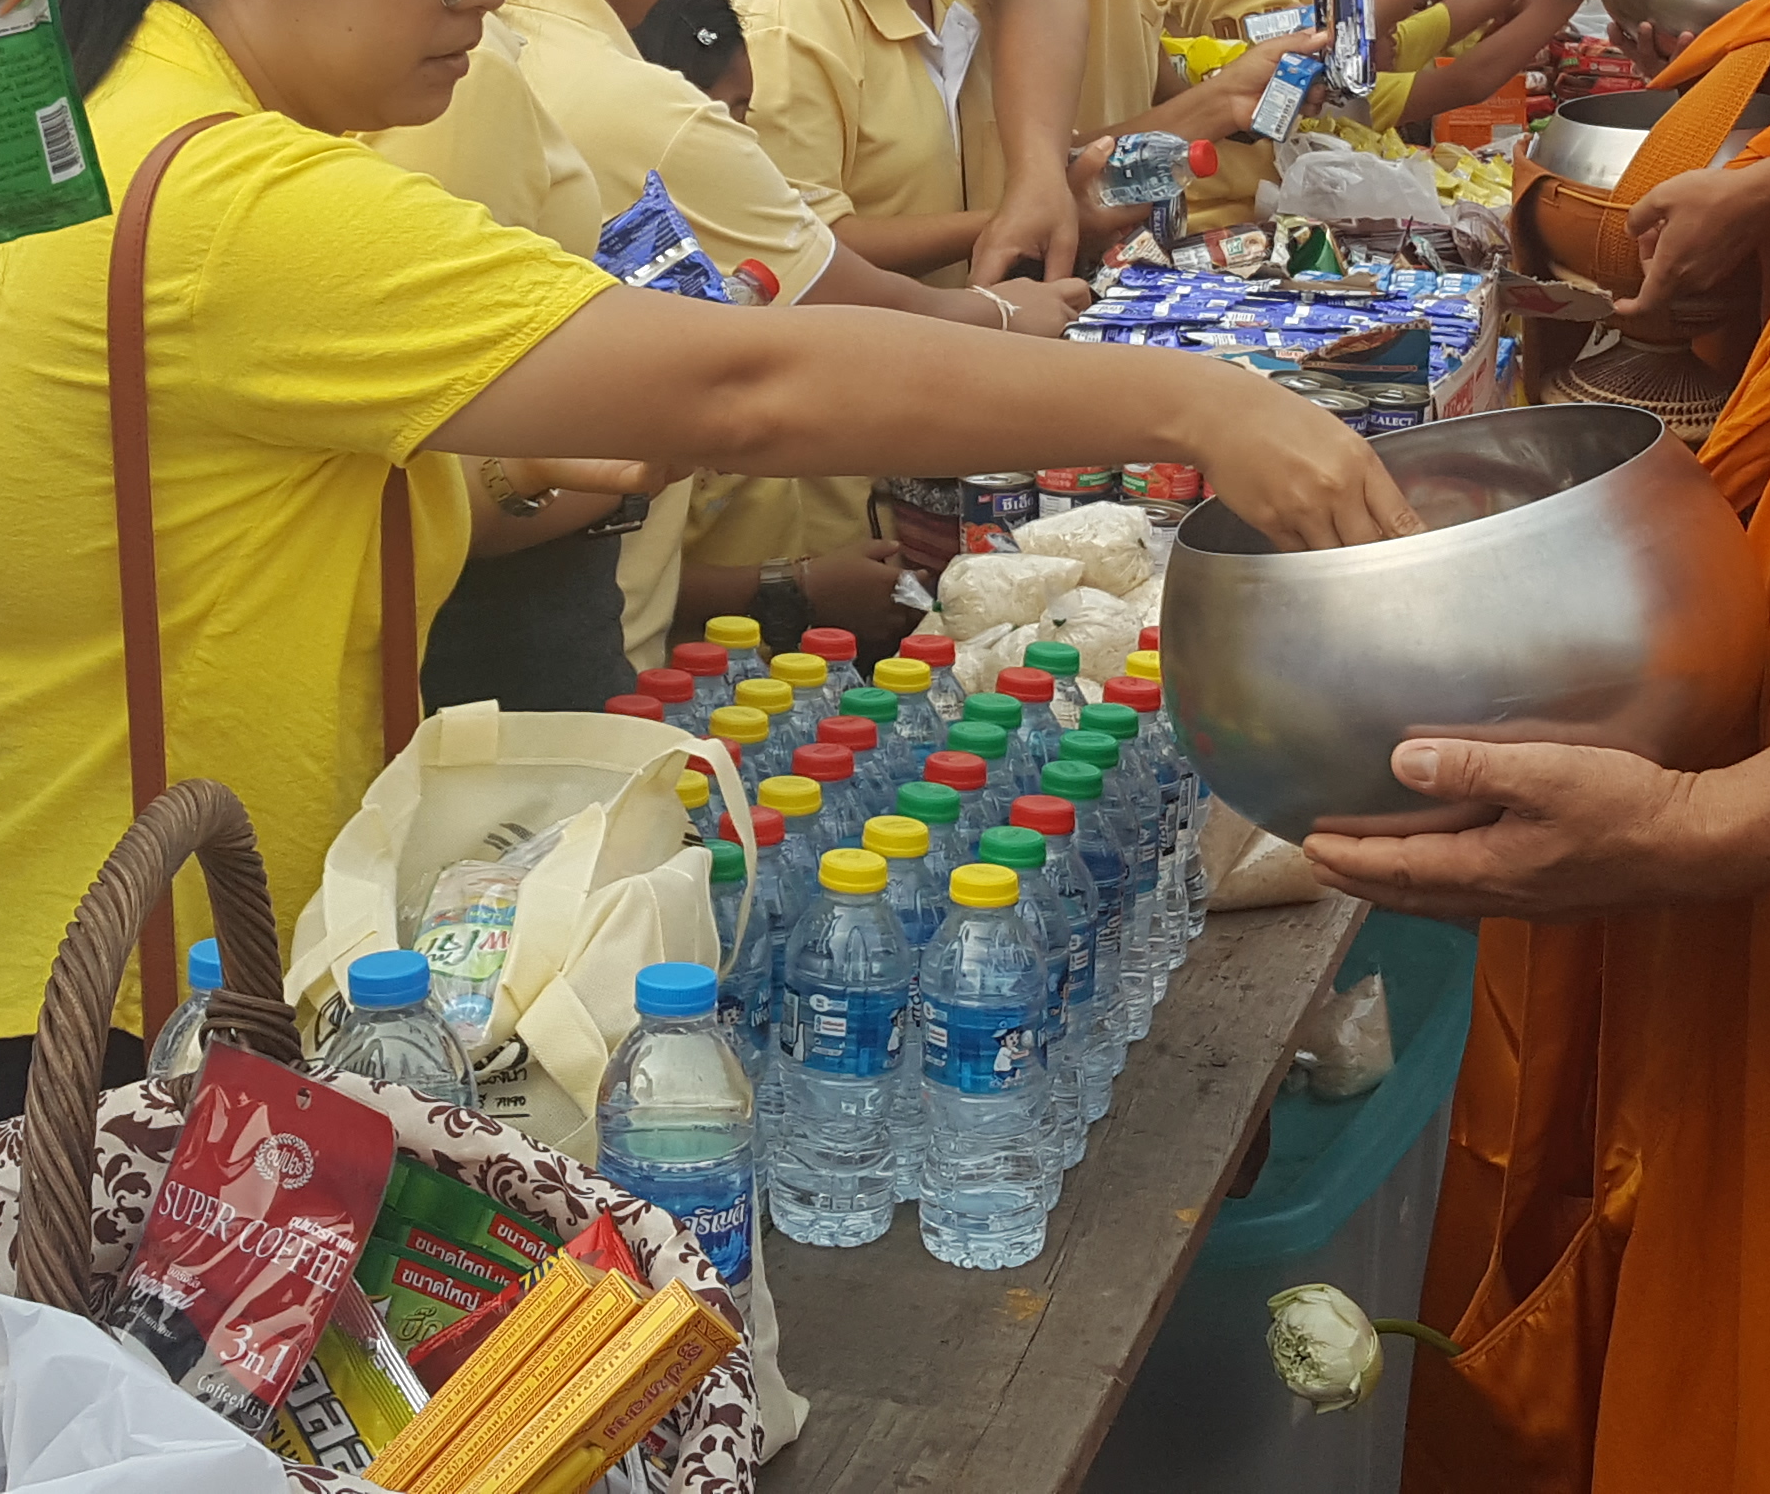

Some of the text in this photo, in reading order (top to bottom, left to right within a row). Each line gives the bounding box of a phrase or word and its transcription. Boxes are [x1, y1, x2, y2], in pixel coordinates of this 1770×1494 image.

[158, 1180, 349, 1294] SUPER COFFEE
[497, 1222, 548, 1260] ขนาดใ
[402, 1268, 481, 1311] ขนาดใหญ่
